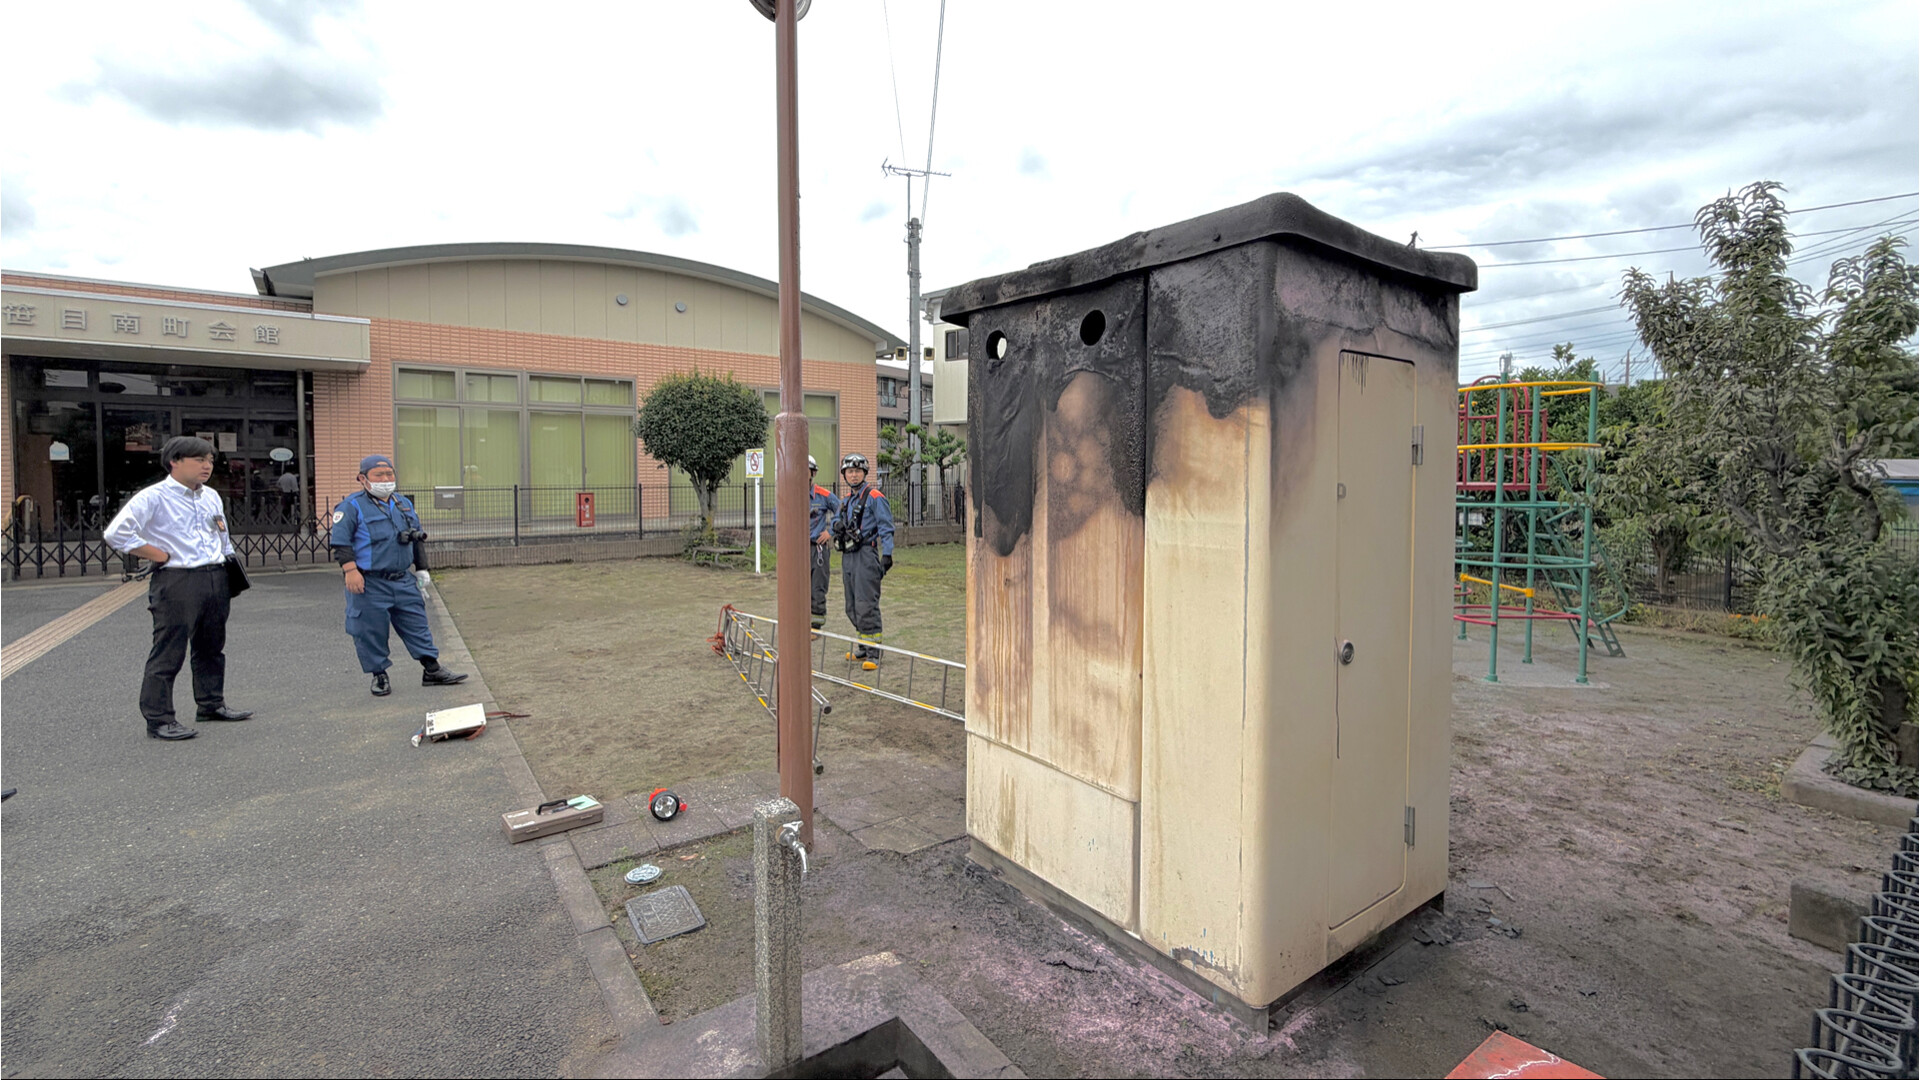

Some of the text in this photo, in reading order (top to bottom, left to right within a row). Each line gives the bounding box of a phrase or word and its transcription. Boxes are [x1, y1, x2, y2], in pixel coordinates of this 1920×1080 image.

[2, 303, 280, 344] 笹目南町会館
